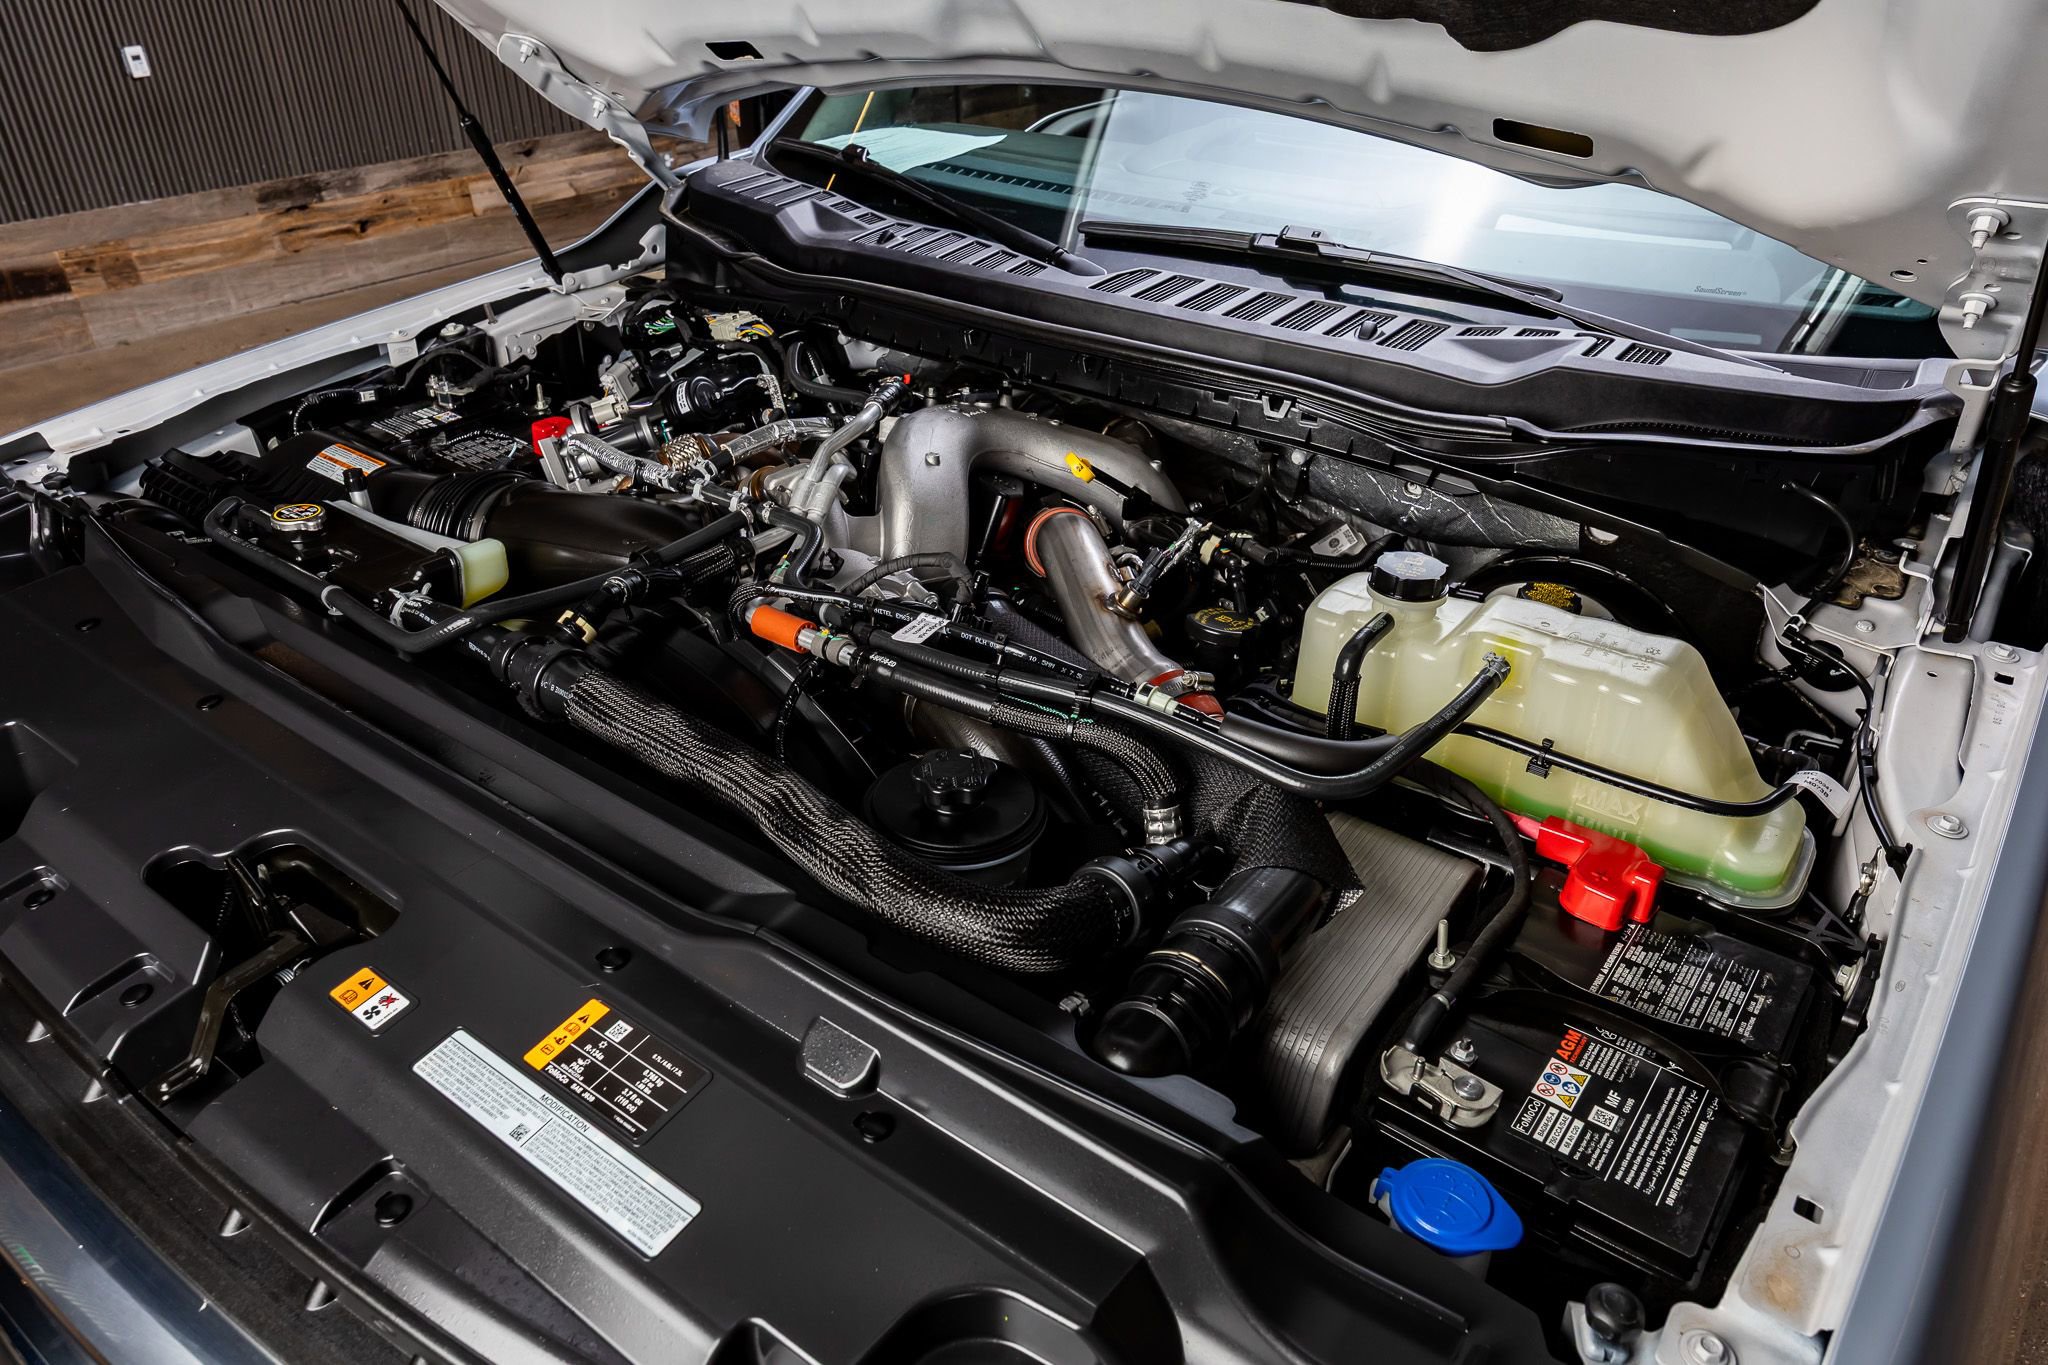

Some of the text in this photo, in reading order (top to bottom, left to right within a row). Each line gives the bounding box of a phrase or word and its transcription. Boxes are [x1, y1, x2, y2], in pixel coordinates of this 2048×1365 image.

[584, 1044, 604, 1060] R-134a
[1556, 1029, 1581, 1060] AGM
[1569, 1036, 1587, 1063] TECHNOLOGY
[545, 1065, 569, 1084] FoMoCo
[570, 1083, 583, 1093] SAE
[569, 1062, 584, 1073] PAG
[621, 1088, 633, 1097] 3.7
[634, 1098, 643, 1106] oz
[1605, 1090, 1621, 1108] MF
[539, 1094, 590, 1132] MODIFICATION
[1516, 1097, 1542, 1133] FoMoCo
[1548, 1115, 1569, 1145] 750 CCA/SAE
[1571, 1125, 1580, 1135] C20
